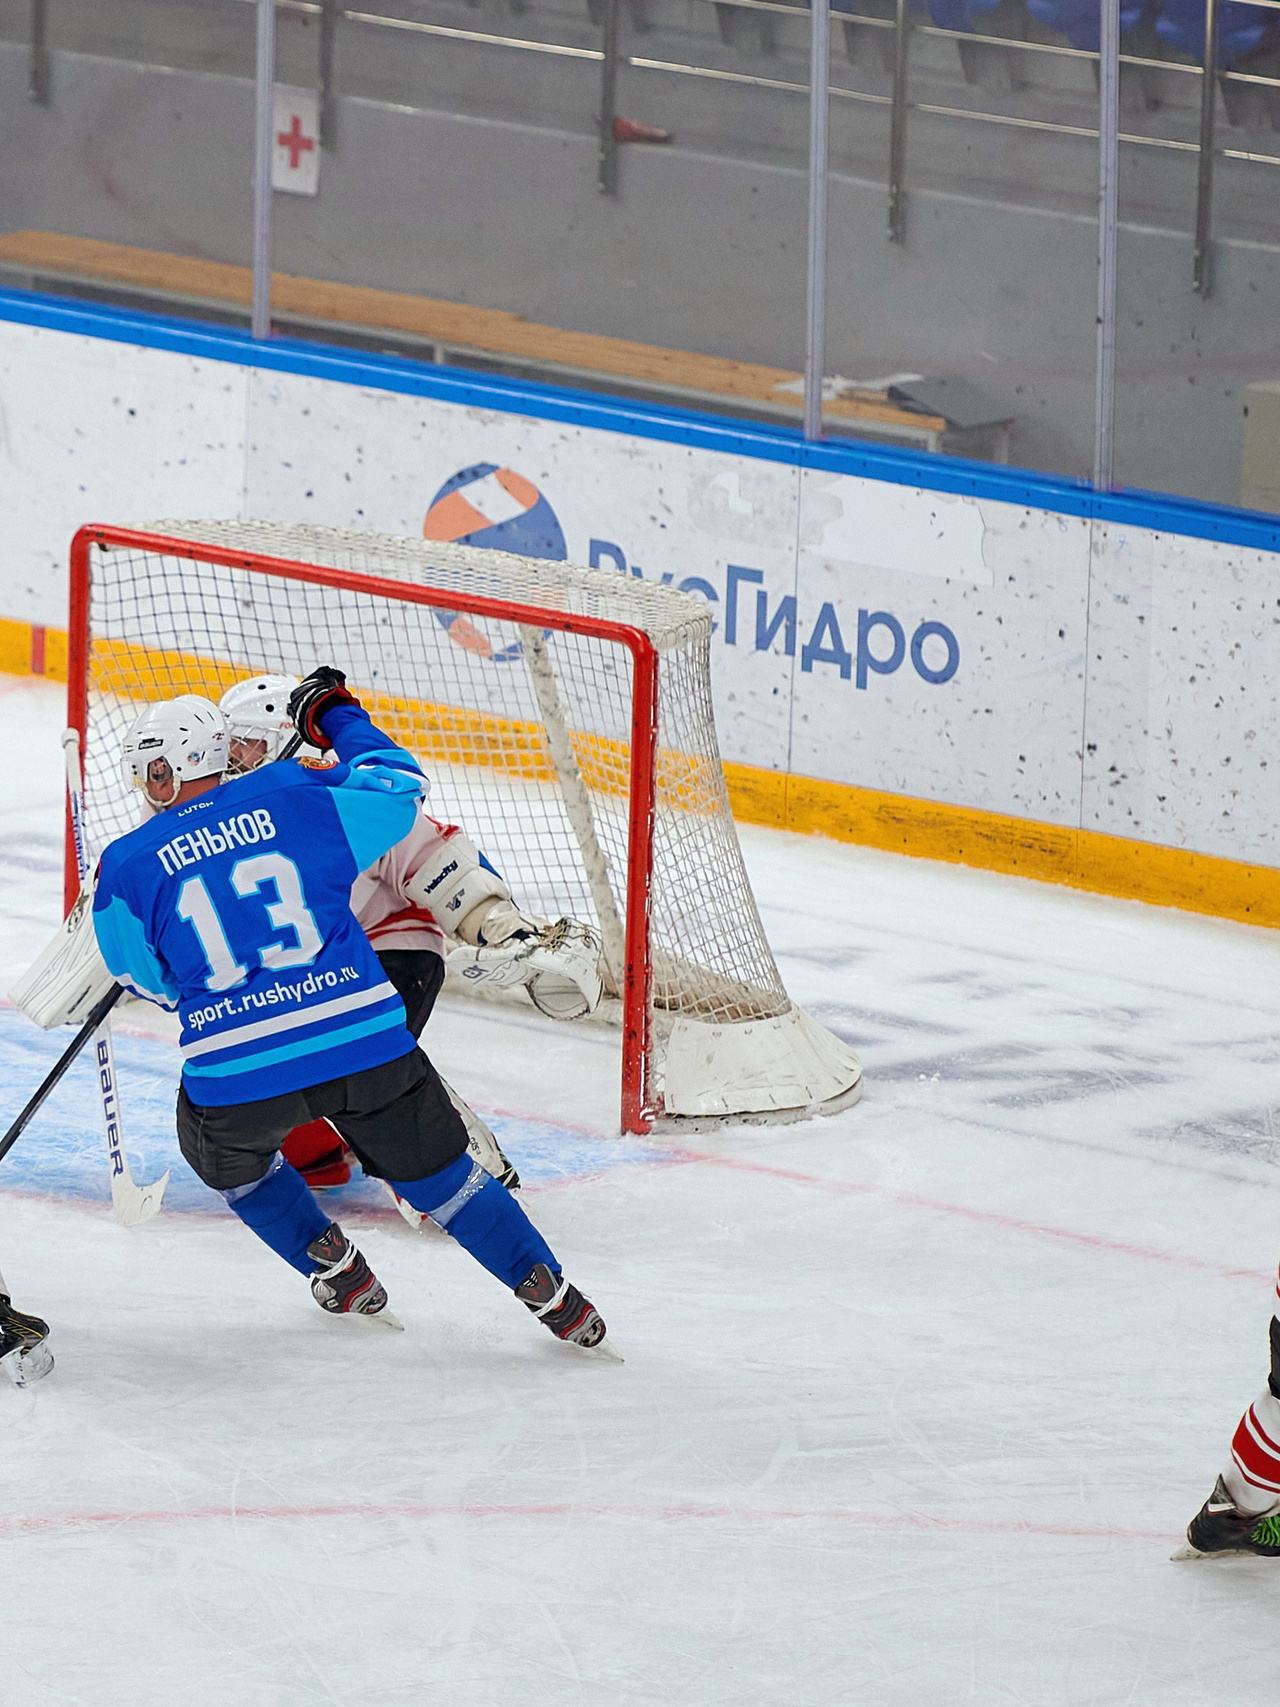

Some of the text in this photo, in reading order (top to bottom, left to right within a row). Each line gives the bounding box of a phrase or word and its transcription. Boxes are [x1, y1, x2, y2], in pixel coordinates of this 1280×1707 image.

[588, 538, 960, 690] Гидро
[156, 808, 277, 877] ПЕНЬКОВ
[175, 850, 325, 993] 13
[187, 964, 360, 1032] sport.rushydro.ru
[96, 1039, 124, 1178] BAUER
